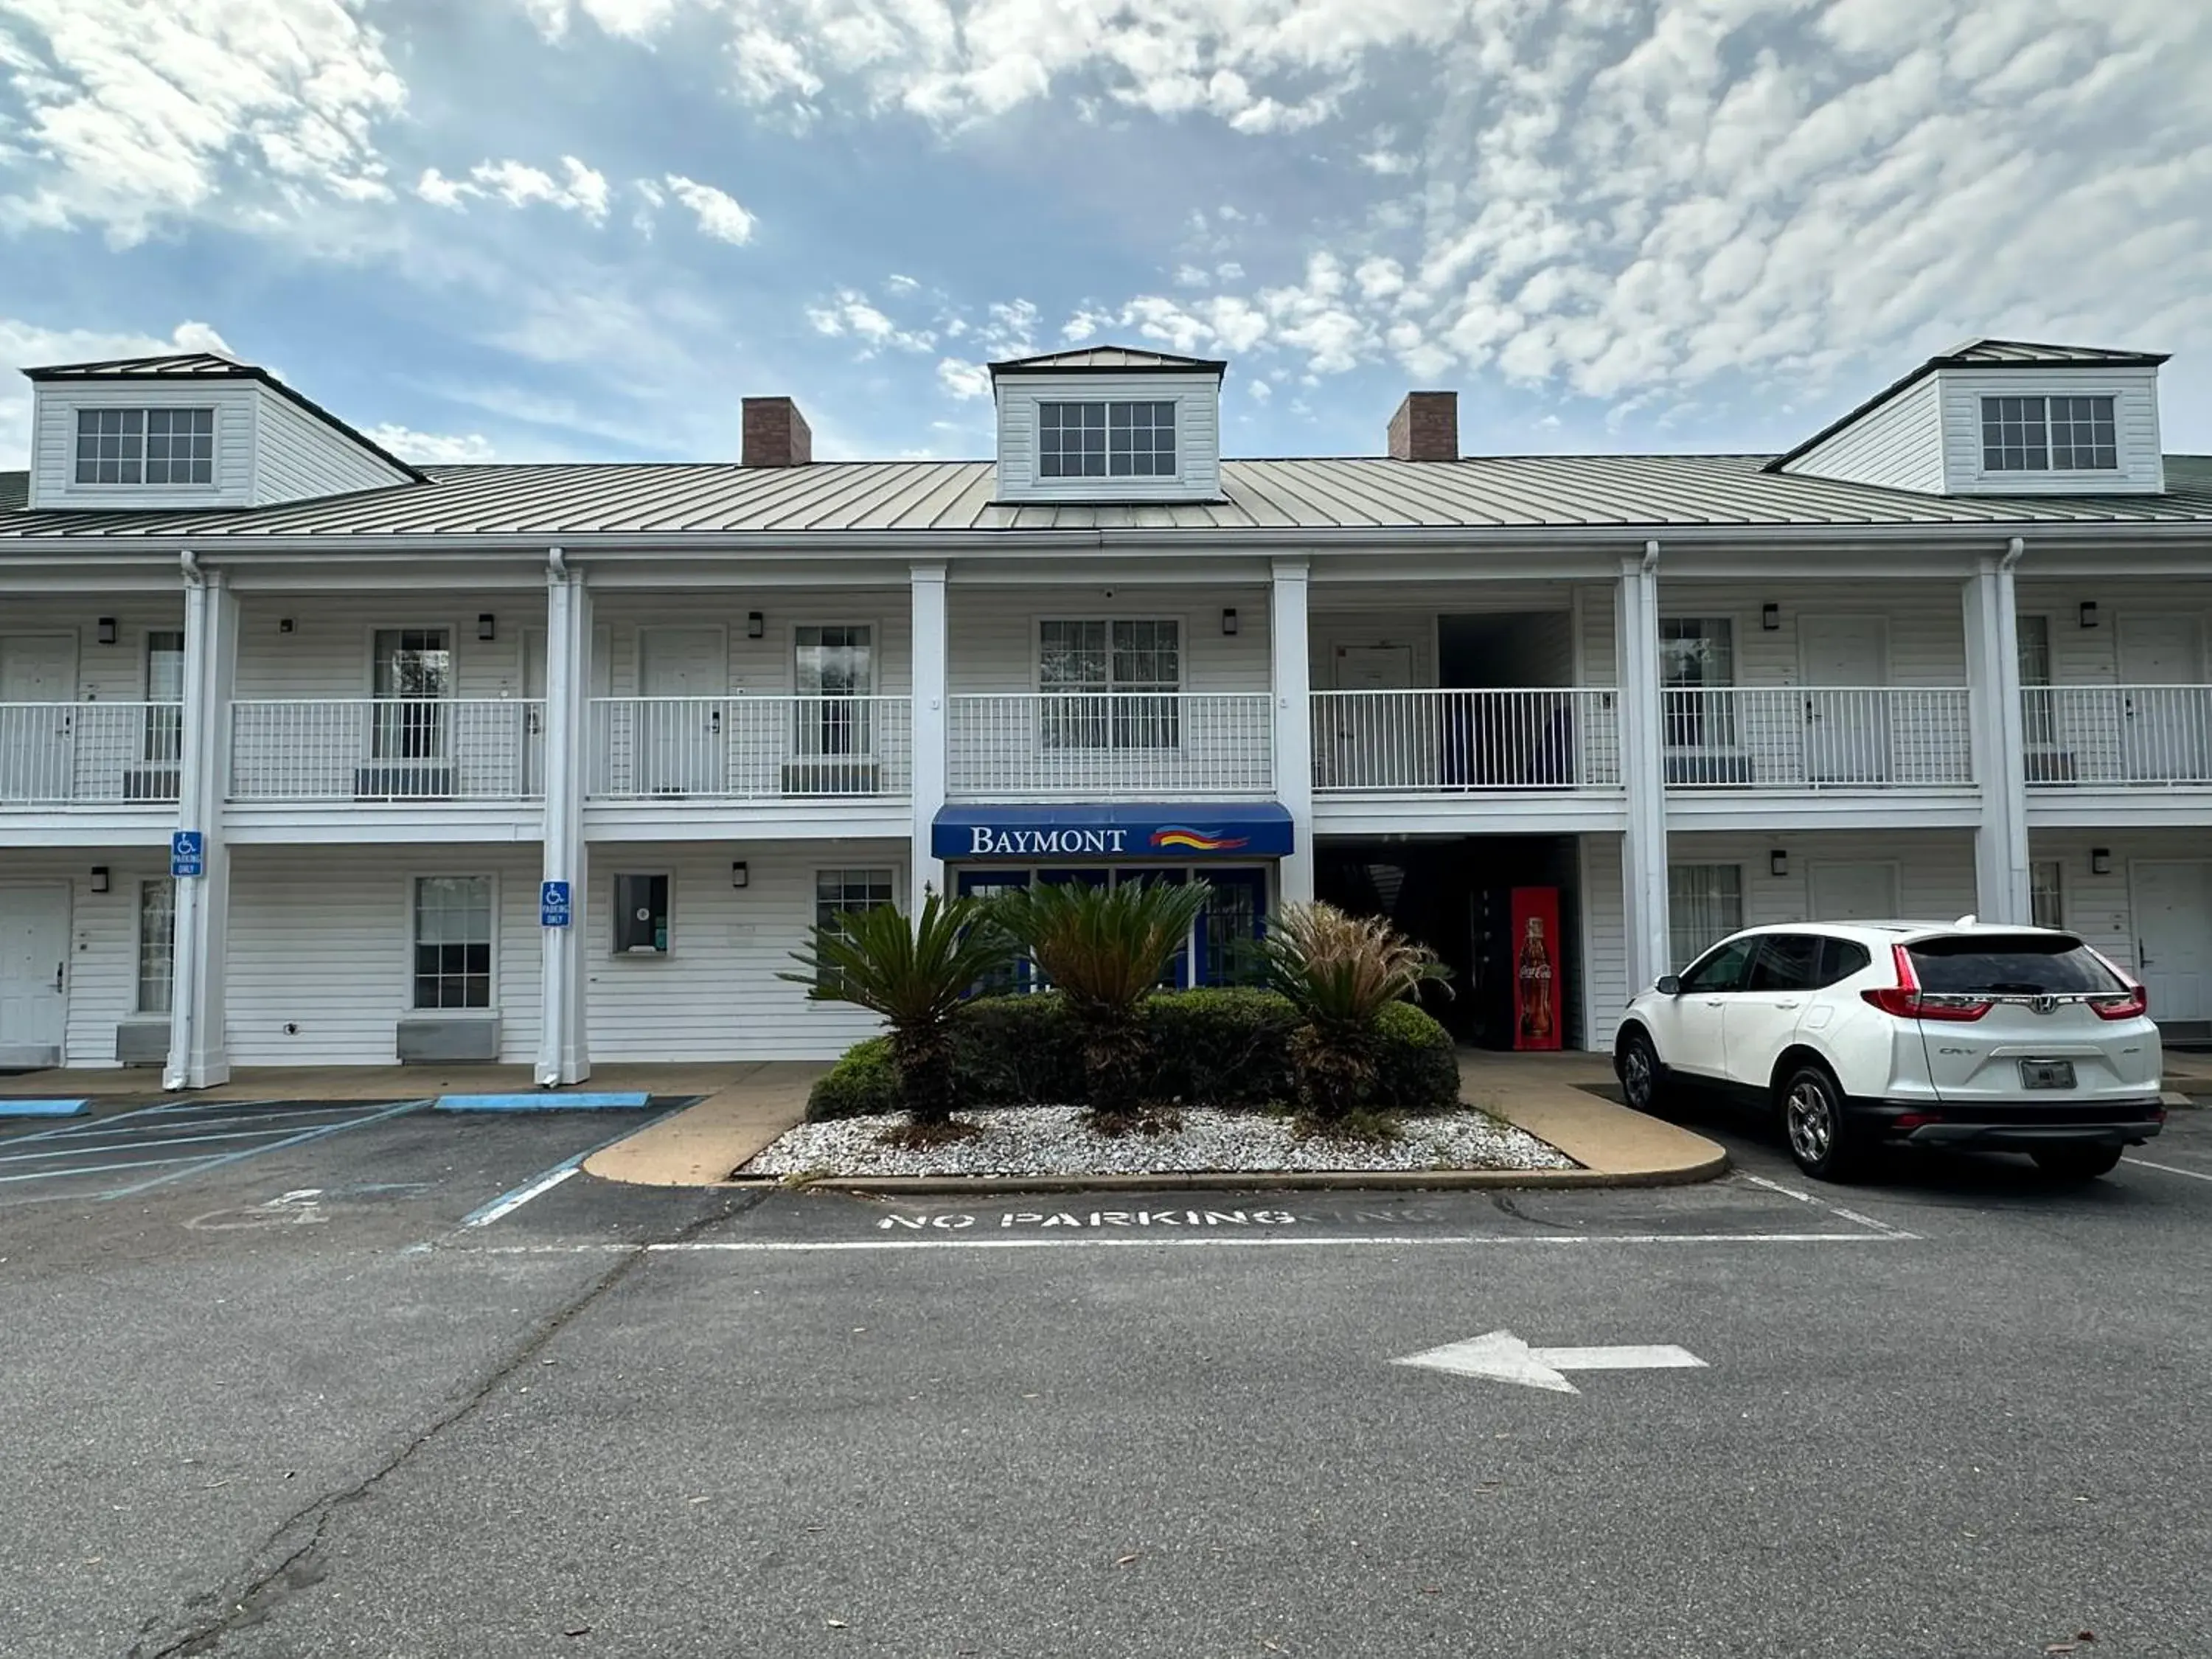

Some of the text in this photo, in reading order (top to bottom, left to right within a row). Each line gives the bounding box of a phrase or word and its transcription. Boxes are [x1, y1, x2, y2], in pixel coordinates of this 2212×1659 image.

[970, 827, 1127, 854] BAYMONT
[173, 855, 201, 863] PARKING
[178, 865, 195, 874] ONLY
[542, 905, 570, 913] PARKING
[546, 915, 563, 924] ONLY
[876, 1214, 976, 1229] NO
[1001, 1210, 1295, 1227] PARKING
